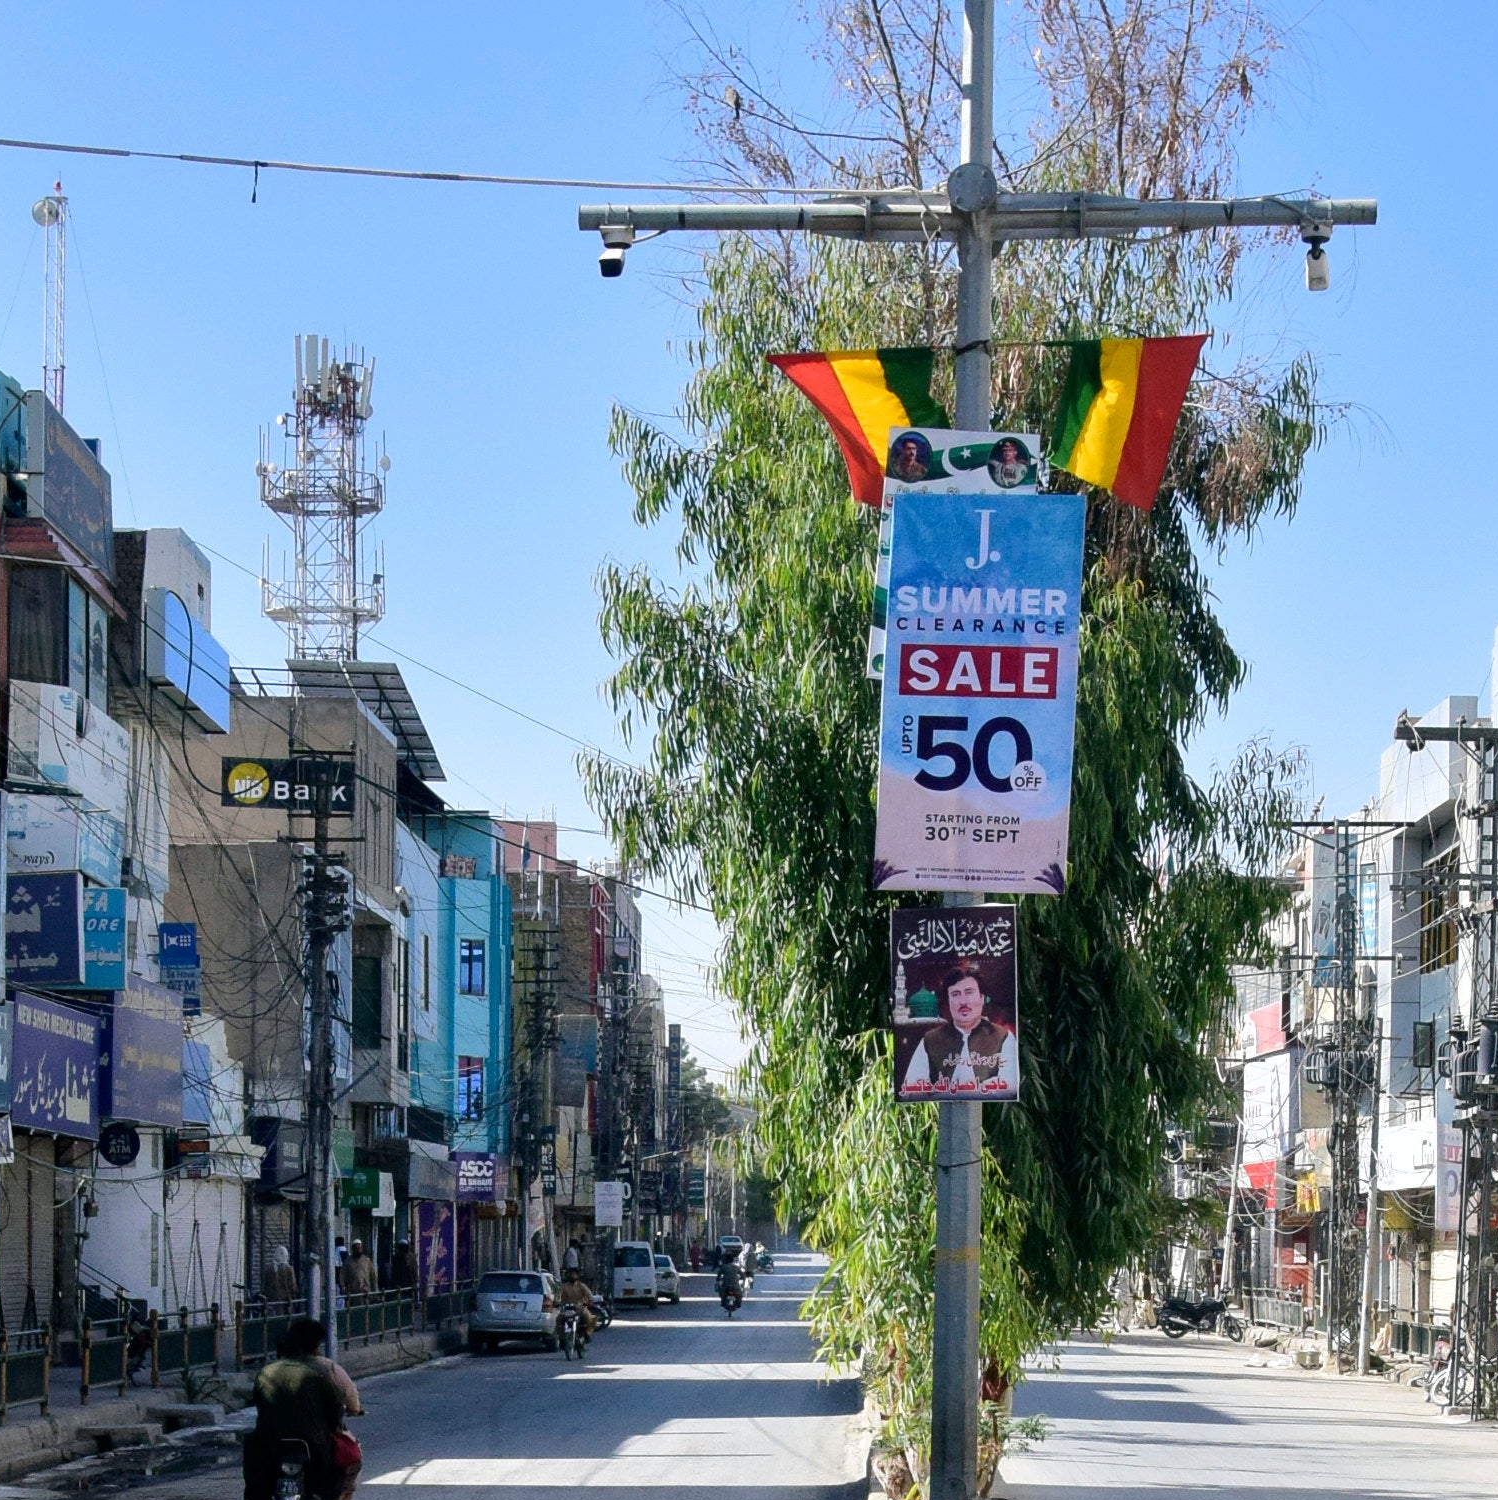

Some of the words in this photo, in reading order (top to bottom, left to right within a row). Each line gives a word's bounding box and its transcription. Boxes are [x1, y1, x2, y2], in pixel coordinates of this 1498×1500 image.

[896, 585, 1069, 617] SUMMER
[896, 617, 1066, 634] CLEARANCE
[907, 649, 1051, 694] SALE
[902, 715, 914, 754] UPTO
[914, 715, 1033, 793] 50
[1014, 776, 1042, 788] OFF
[274, 781, 347, 801] Bak
[925, 814, 983, 824] STARTING
[986, 816, 1020, 825] FROM
[925, 826, 966, 841] 30TH
[972, 829, 1020, 843] SEPT
[987, 916, 1012, 931] جشن
[167, 979, 196, 992] ATM
[18, 1004, 32, 1025] NEW
[32, 1008, 52, 1032] SHIFA
[51, 1013, 76, 1039] MEDICAL
[76, 1020, 94, 1044] STORE
[981, 1078, 1008, 1095] حاجی
[348, 1194, 373, 1207] ATM
